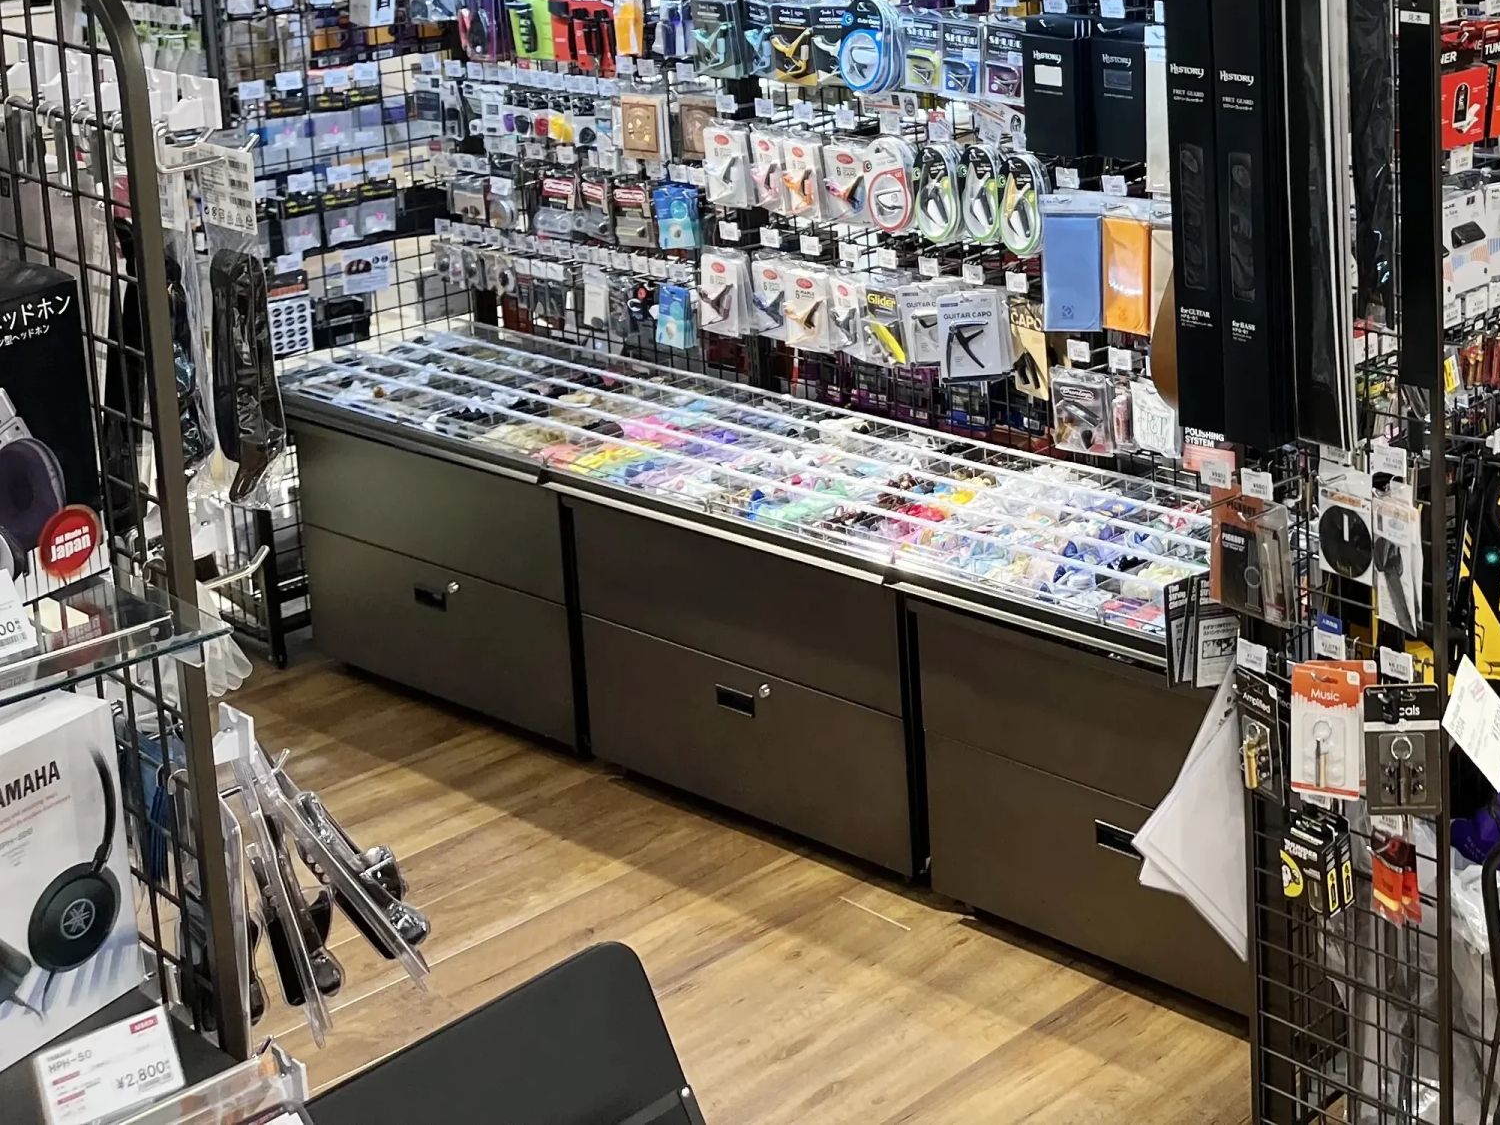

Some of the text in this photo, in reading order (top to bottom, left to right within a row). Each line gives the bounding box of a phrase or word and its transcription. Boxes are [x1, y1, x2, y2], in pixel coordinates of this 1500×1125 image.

[867, 293, 898, 309] Glider
[0, 295, 71, 331] ッドホン
[943, 310, 993, 320] GUITAR CAPO
[1010, 310, 1043, 329] CAPO
[1184, 426, 1225, 443] POLISHING
[1184, 435, 1215, 449] SYSTEM
[50, 533, 92, 563] Japan
[1242, 691, 1272, 715] Amplified
[1310, 688, 1340, 703] Music
[115, 1060, 166, 1090] ¥2,800
